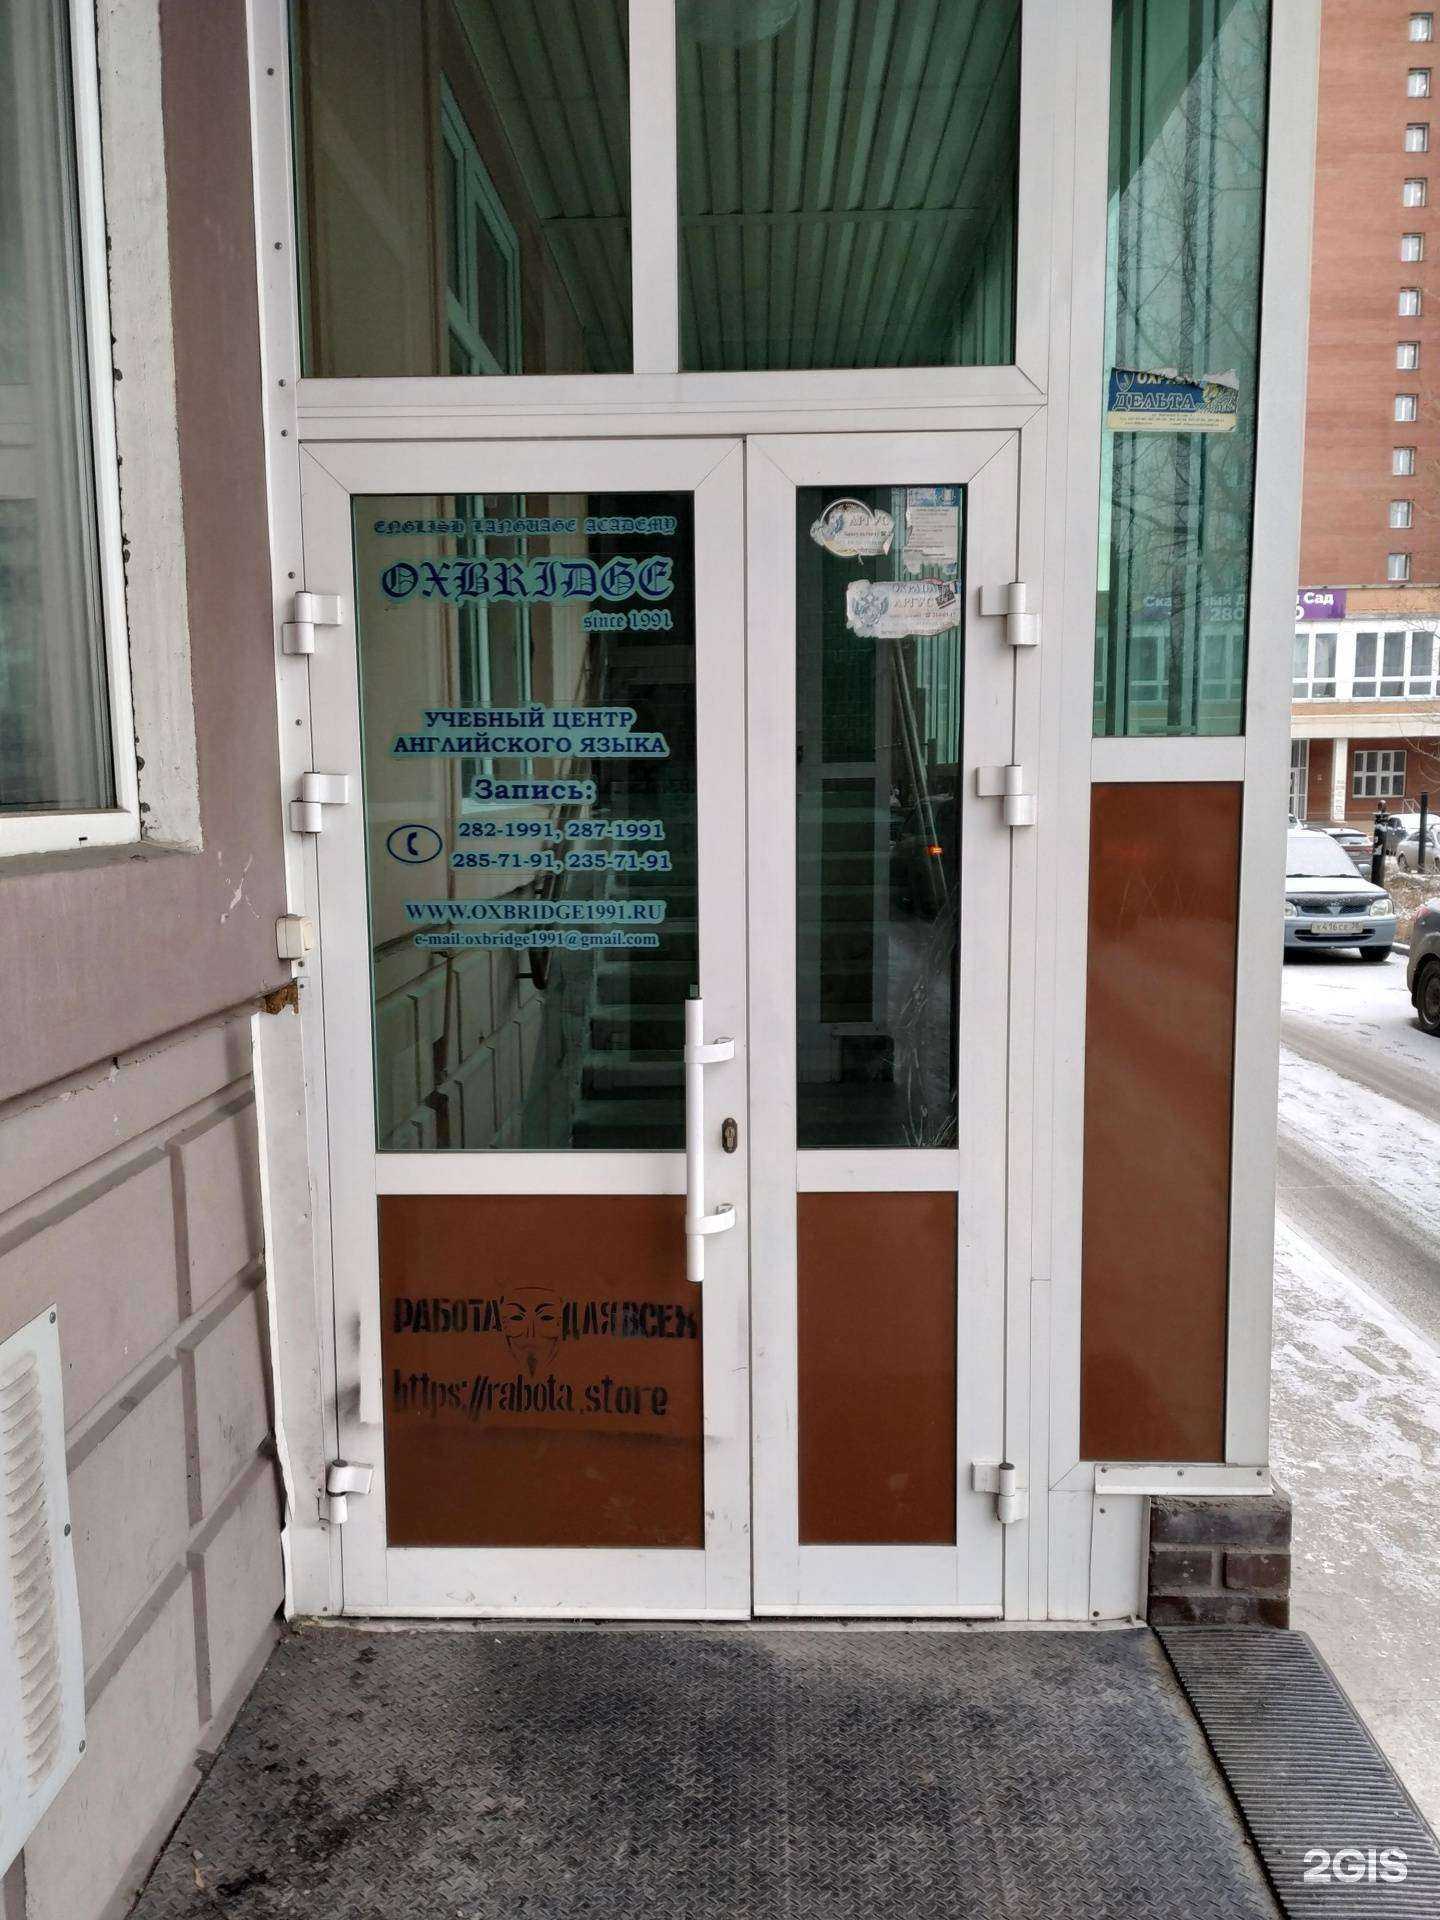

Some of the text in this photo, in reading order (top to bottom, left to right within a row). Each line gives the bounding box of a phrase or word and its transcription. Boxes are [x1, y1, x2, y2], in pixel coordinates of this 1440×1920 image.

[1112, 392, 1197, 412] ДЕЛЬТА
[472, 518, 577, 534] LANGUAGE
[585, 517, 677, 534] ACADEMY
[382, 559, 672, 599] OXBRIDGE
[1303, 591, 1335, 606] Сад
[583, 611, 673, 629] since 1991
[424, 703, 634, 732] УЧЕБНЫЙ ЦЕНТР
[393, 732, 667, 753] АНГЛИЙСКОГО ЯЗЫКА
[475, 778, 594, 800] Запись:
[458, 822, 664, 840] 282-1991, 287-1991
[452, 853, 670, 870] 285-71-91, 235-71-91
[405, 904, 665, 921] WWW.OXBRIDGE1991.RU
[393, 1296, 504, 1334] РАБОТА
